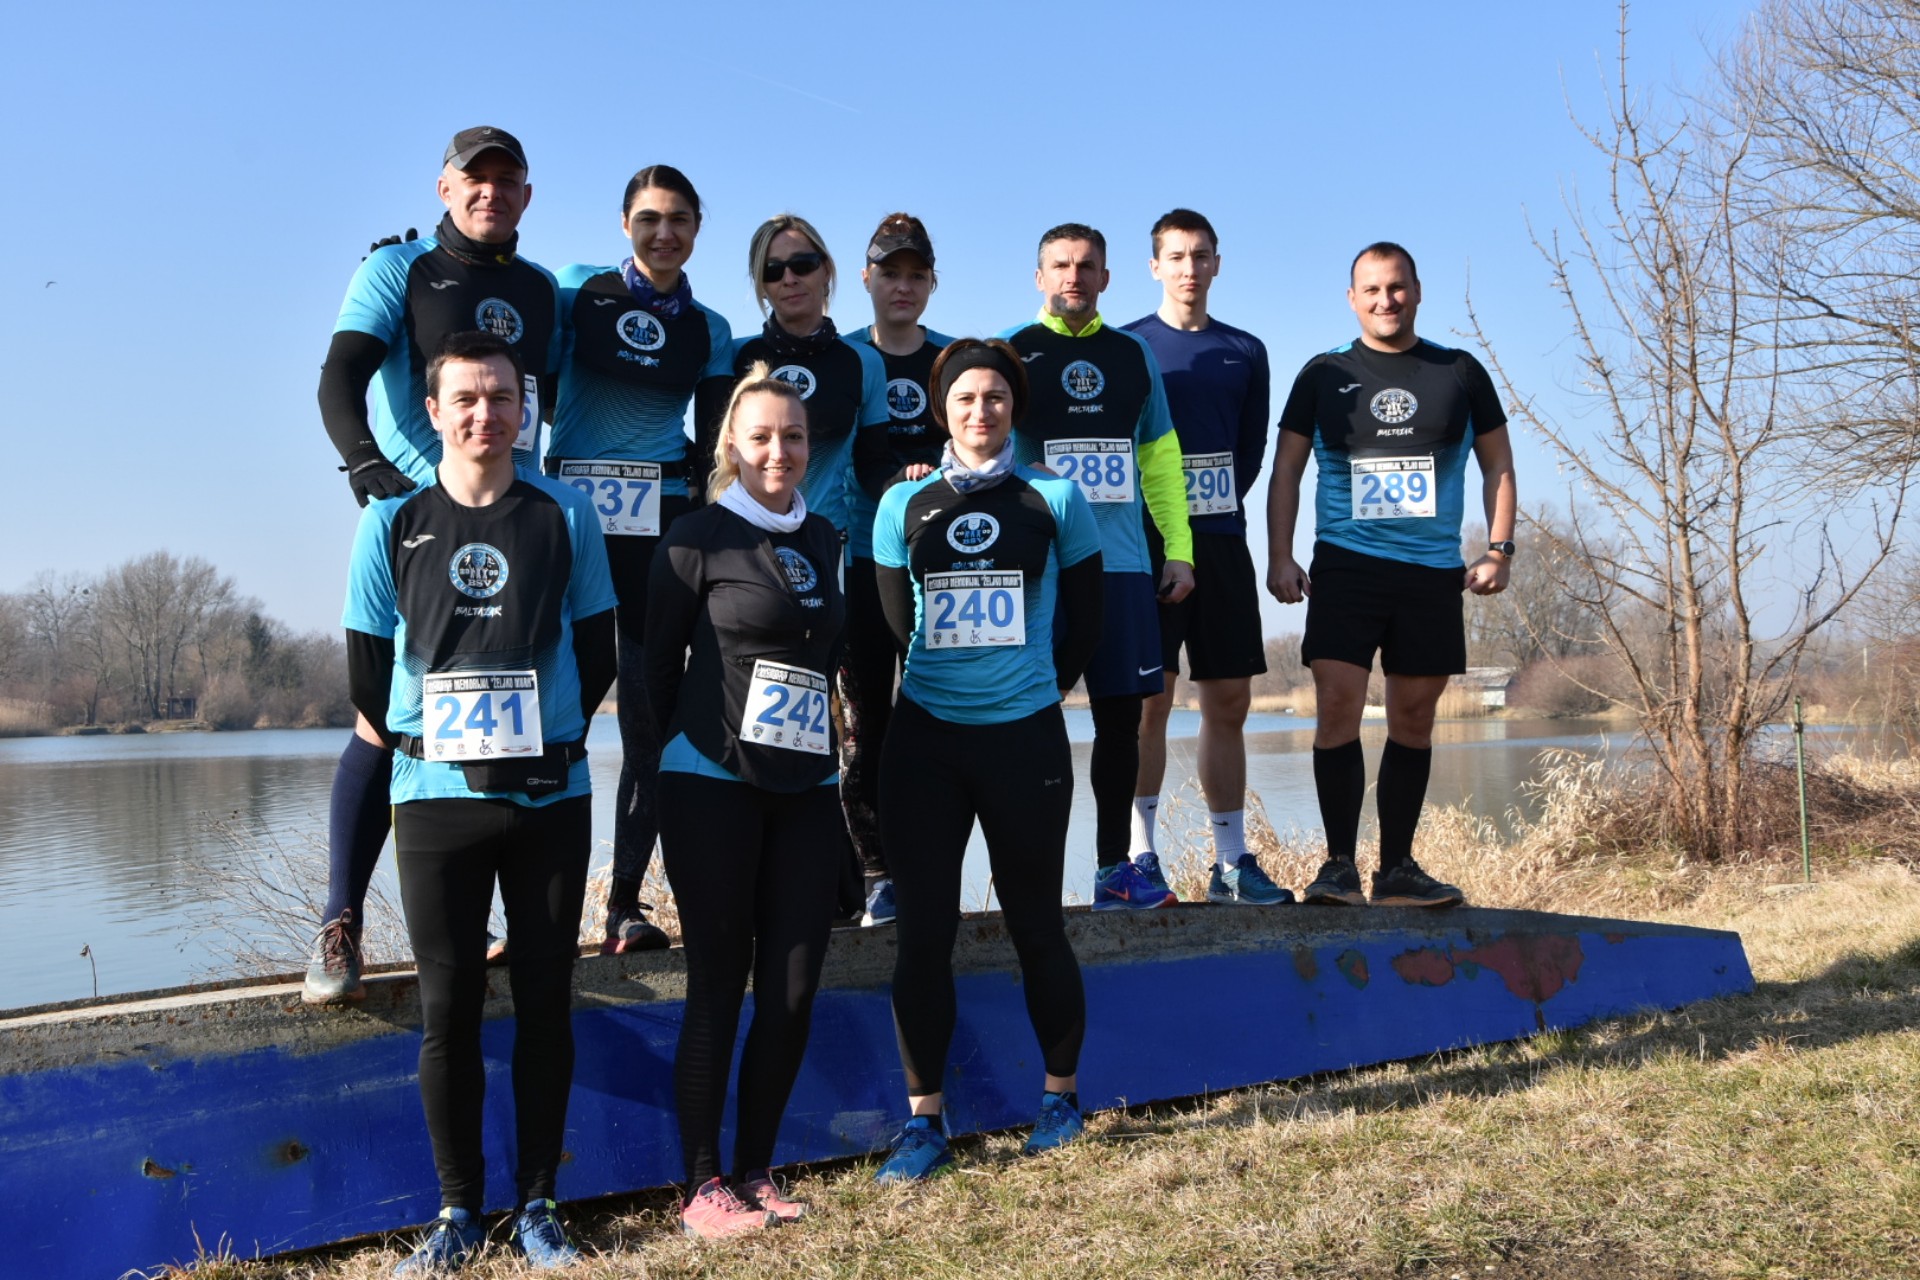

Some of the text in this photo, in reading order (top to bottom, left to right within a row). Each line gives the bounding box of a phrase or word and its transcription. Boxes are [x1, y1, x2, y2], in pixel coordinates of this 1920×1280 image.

[1056, 454, 1126, 487] 288
[1183, 468, 1230, 500] 290
[1361, 472, 1428, 505] 289
[468, 579, 492, 588] BSV
[454, 603, 502, 617] BALTAZAR
[799, 597, 825, 609] TAZAR
[934, 589, 1014, 630] 240
[435, 692, 524, 739] 241
[756, 684, 825, 734] 242
